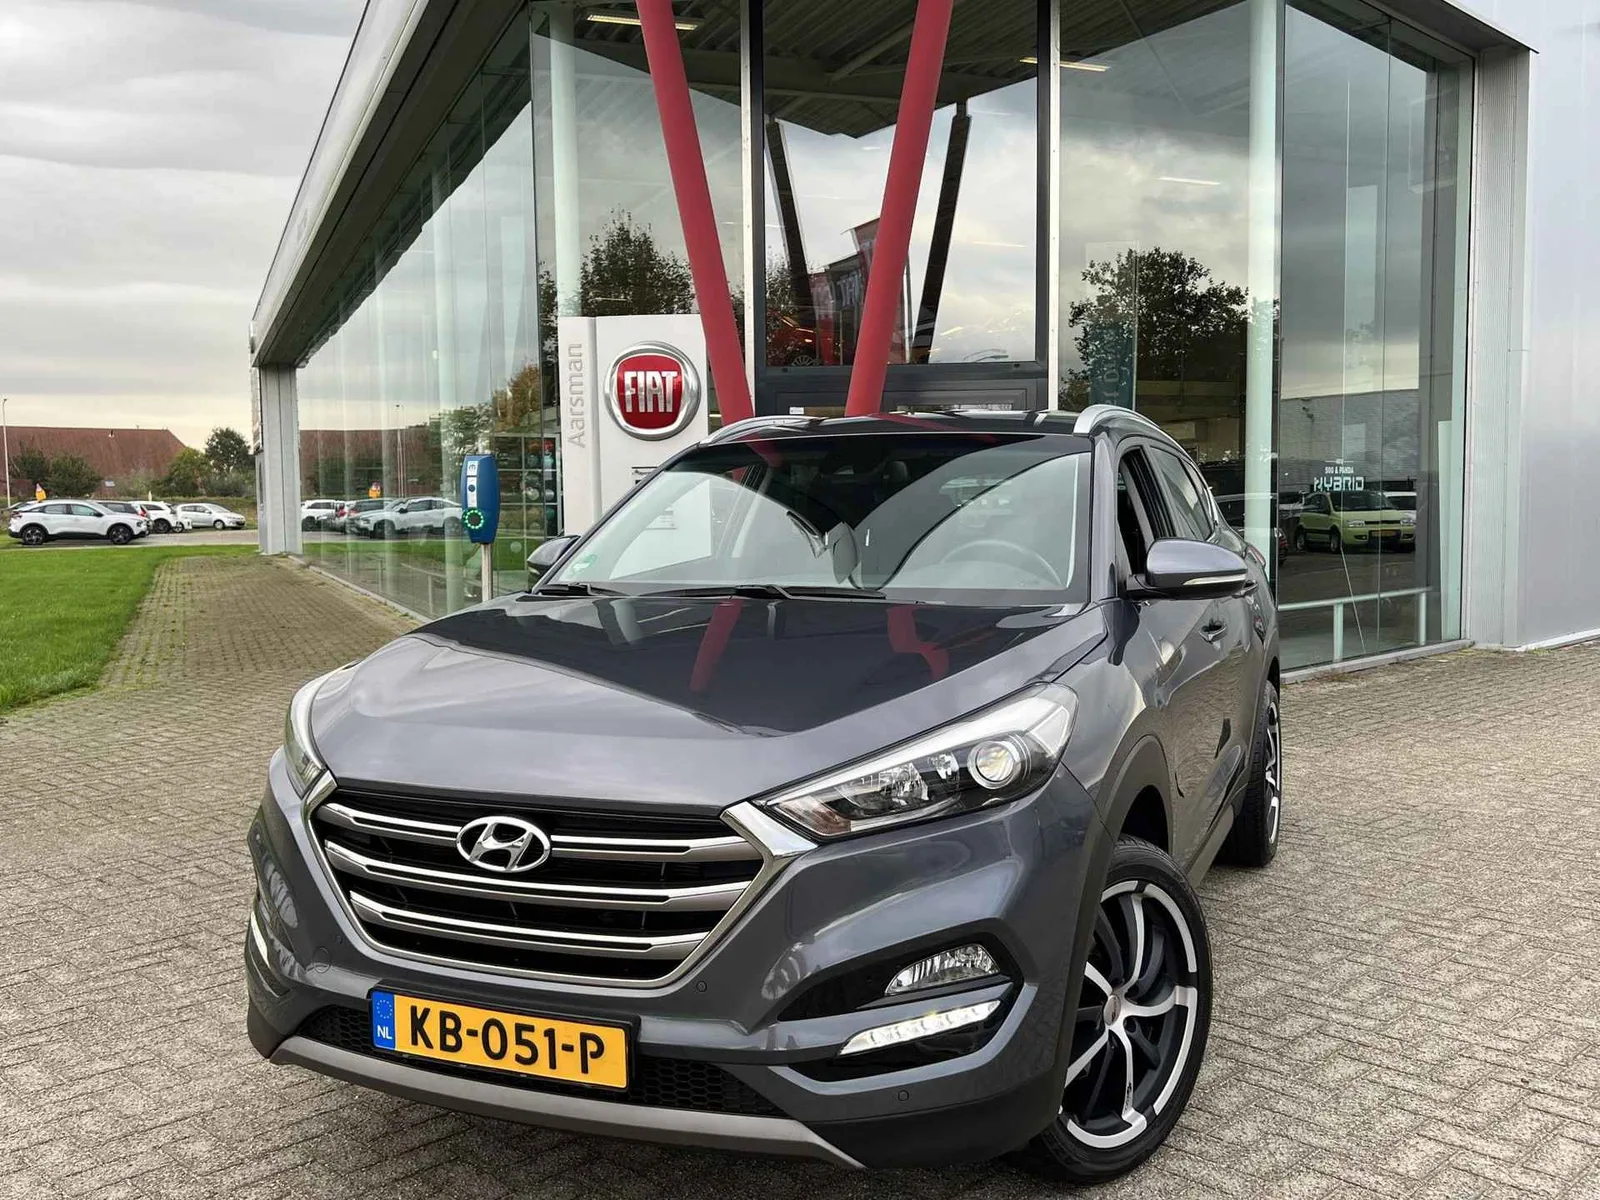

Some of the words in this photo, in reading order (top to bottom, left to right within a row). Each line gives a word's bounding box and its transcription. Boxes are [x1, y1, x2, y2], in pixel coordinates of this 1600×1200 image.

[567, 343, 586, 449] Aarsman
[623, 370, 679, 413] FIAT
[377, 1025, 393, 1040] NL
[409, 1005, 605, 1075] KB-051-P
